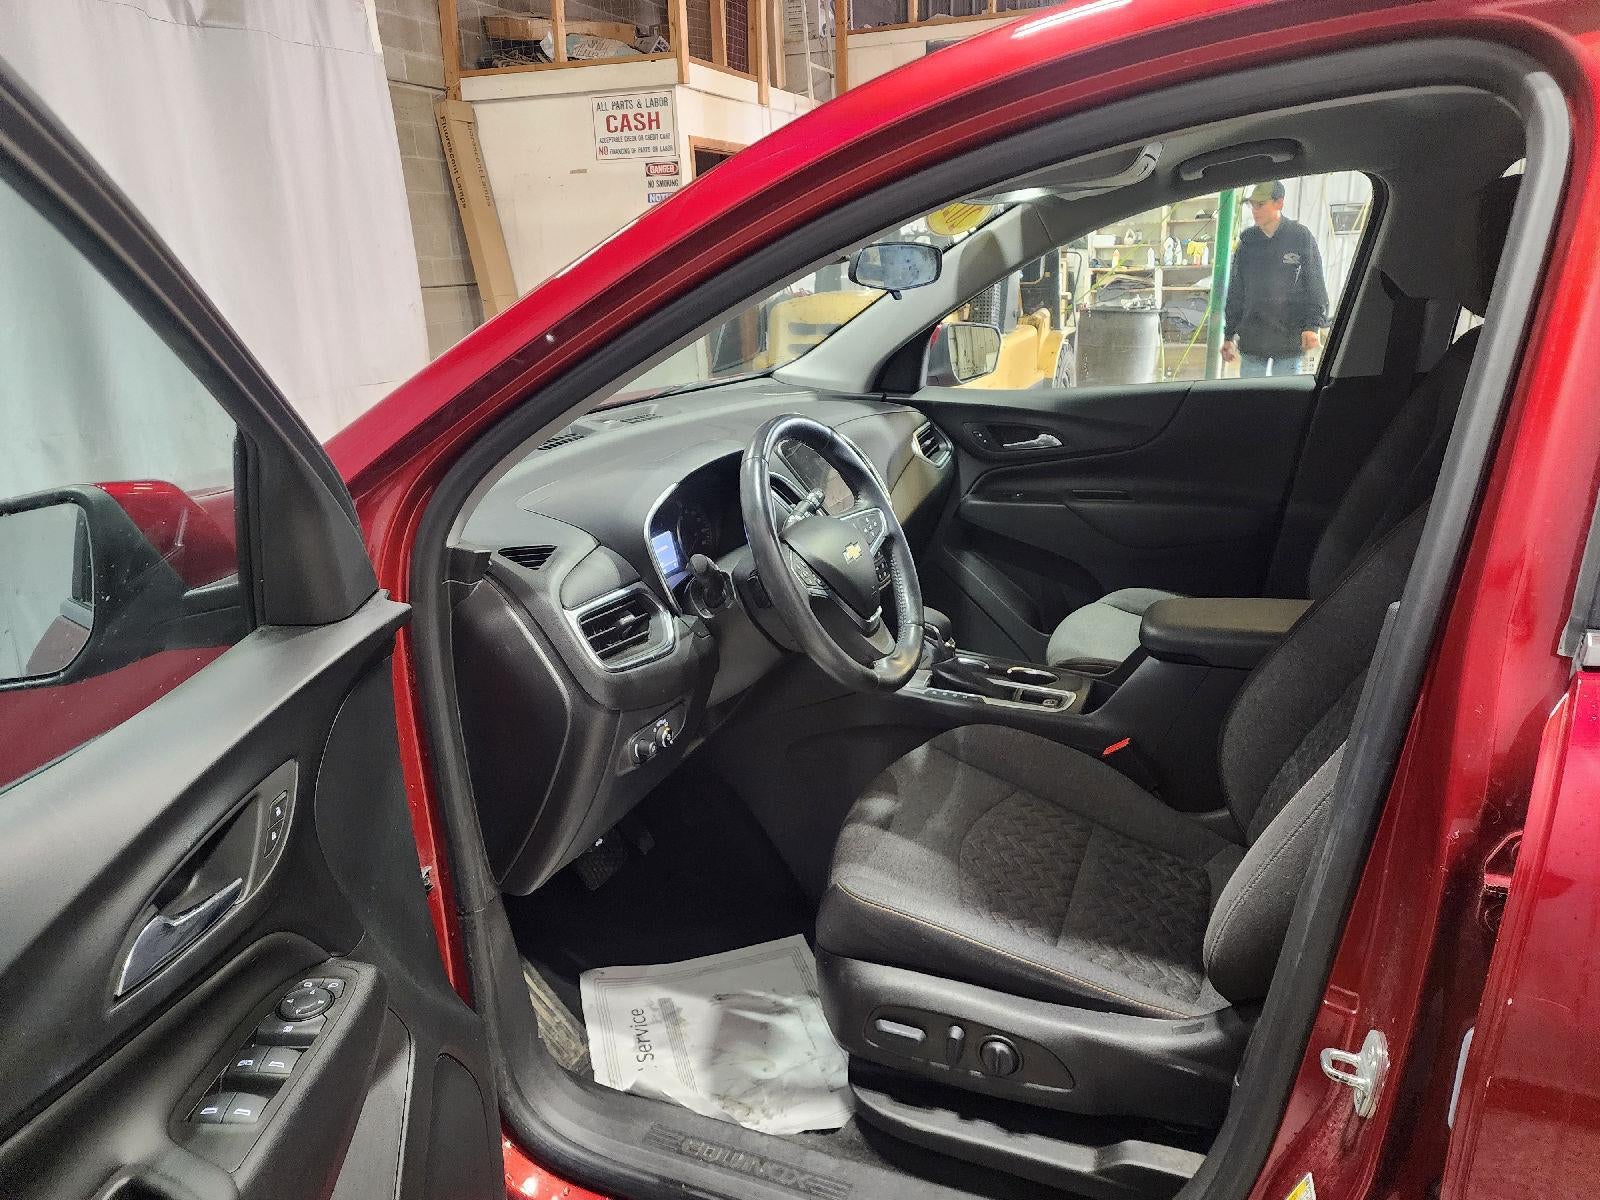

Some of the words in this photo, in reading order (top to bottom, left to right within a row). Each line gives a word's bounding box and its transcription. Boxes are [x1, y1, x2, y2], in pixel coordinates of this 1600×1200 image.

[597, 101, 609, 111] ALL
[612, 99, 634, 111] PARTS
[637, 98, 643, 109] &
[646, 96, 669, 108] LABOR
[605, 111, 661, 133] CASH
[598, 146, 609, 156] NO
[440, 116, 459, 174] Fluorescent
[455, 176, 466, 209] Lamps
[649, 164, 675, 174] DANGER
[480, 175, 491, 207] Lamps
[648, 179, 655, 188] NO
[656, 178, 679, 187] SMOKING
[630, 1007, 655, 1064] Service
